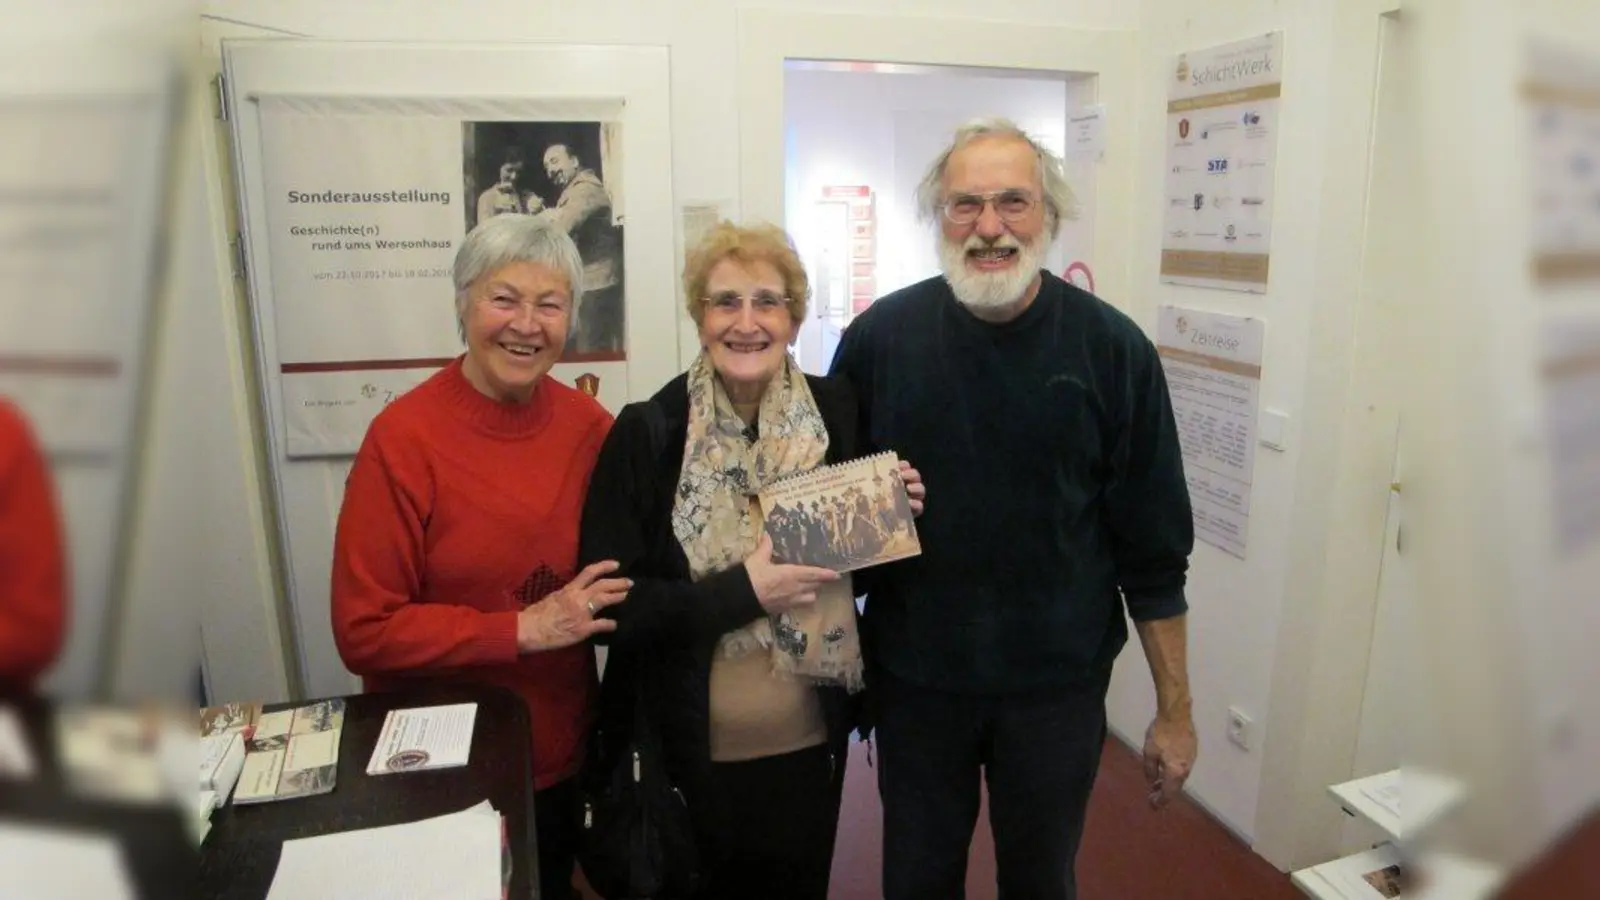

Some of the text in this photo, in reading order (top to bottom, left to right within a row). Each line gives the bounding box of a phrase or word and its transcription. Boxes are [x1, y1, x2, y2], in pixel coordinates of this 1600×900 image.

[1192, 52, 1272, 87] SchichtWerk
[1208, 159, 1228, 171] STA
[288, 190, 451, 205] Sonderausstellung
[290, 225, 380, 237] Geschichte(n)
[312, 239, 452, 251] rund ums Wersonhaus
[1191, 328, 1239, 351] Zeitreise
